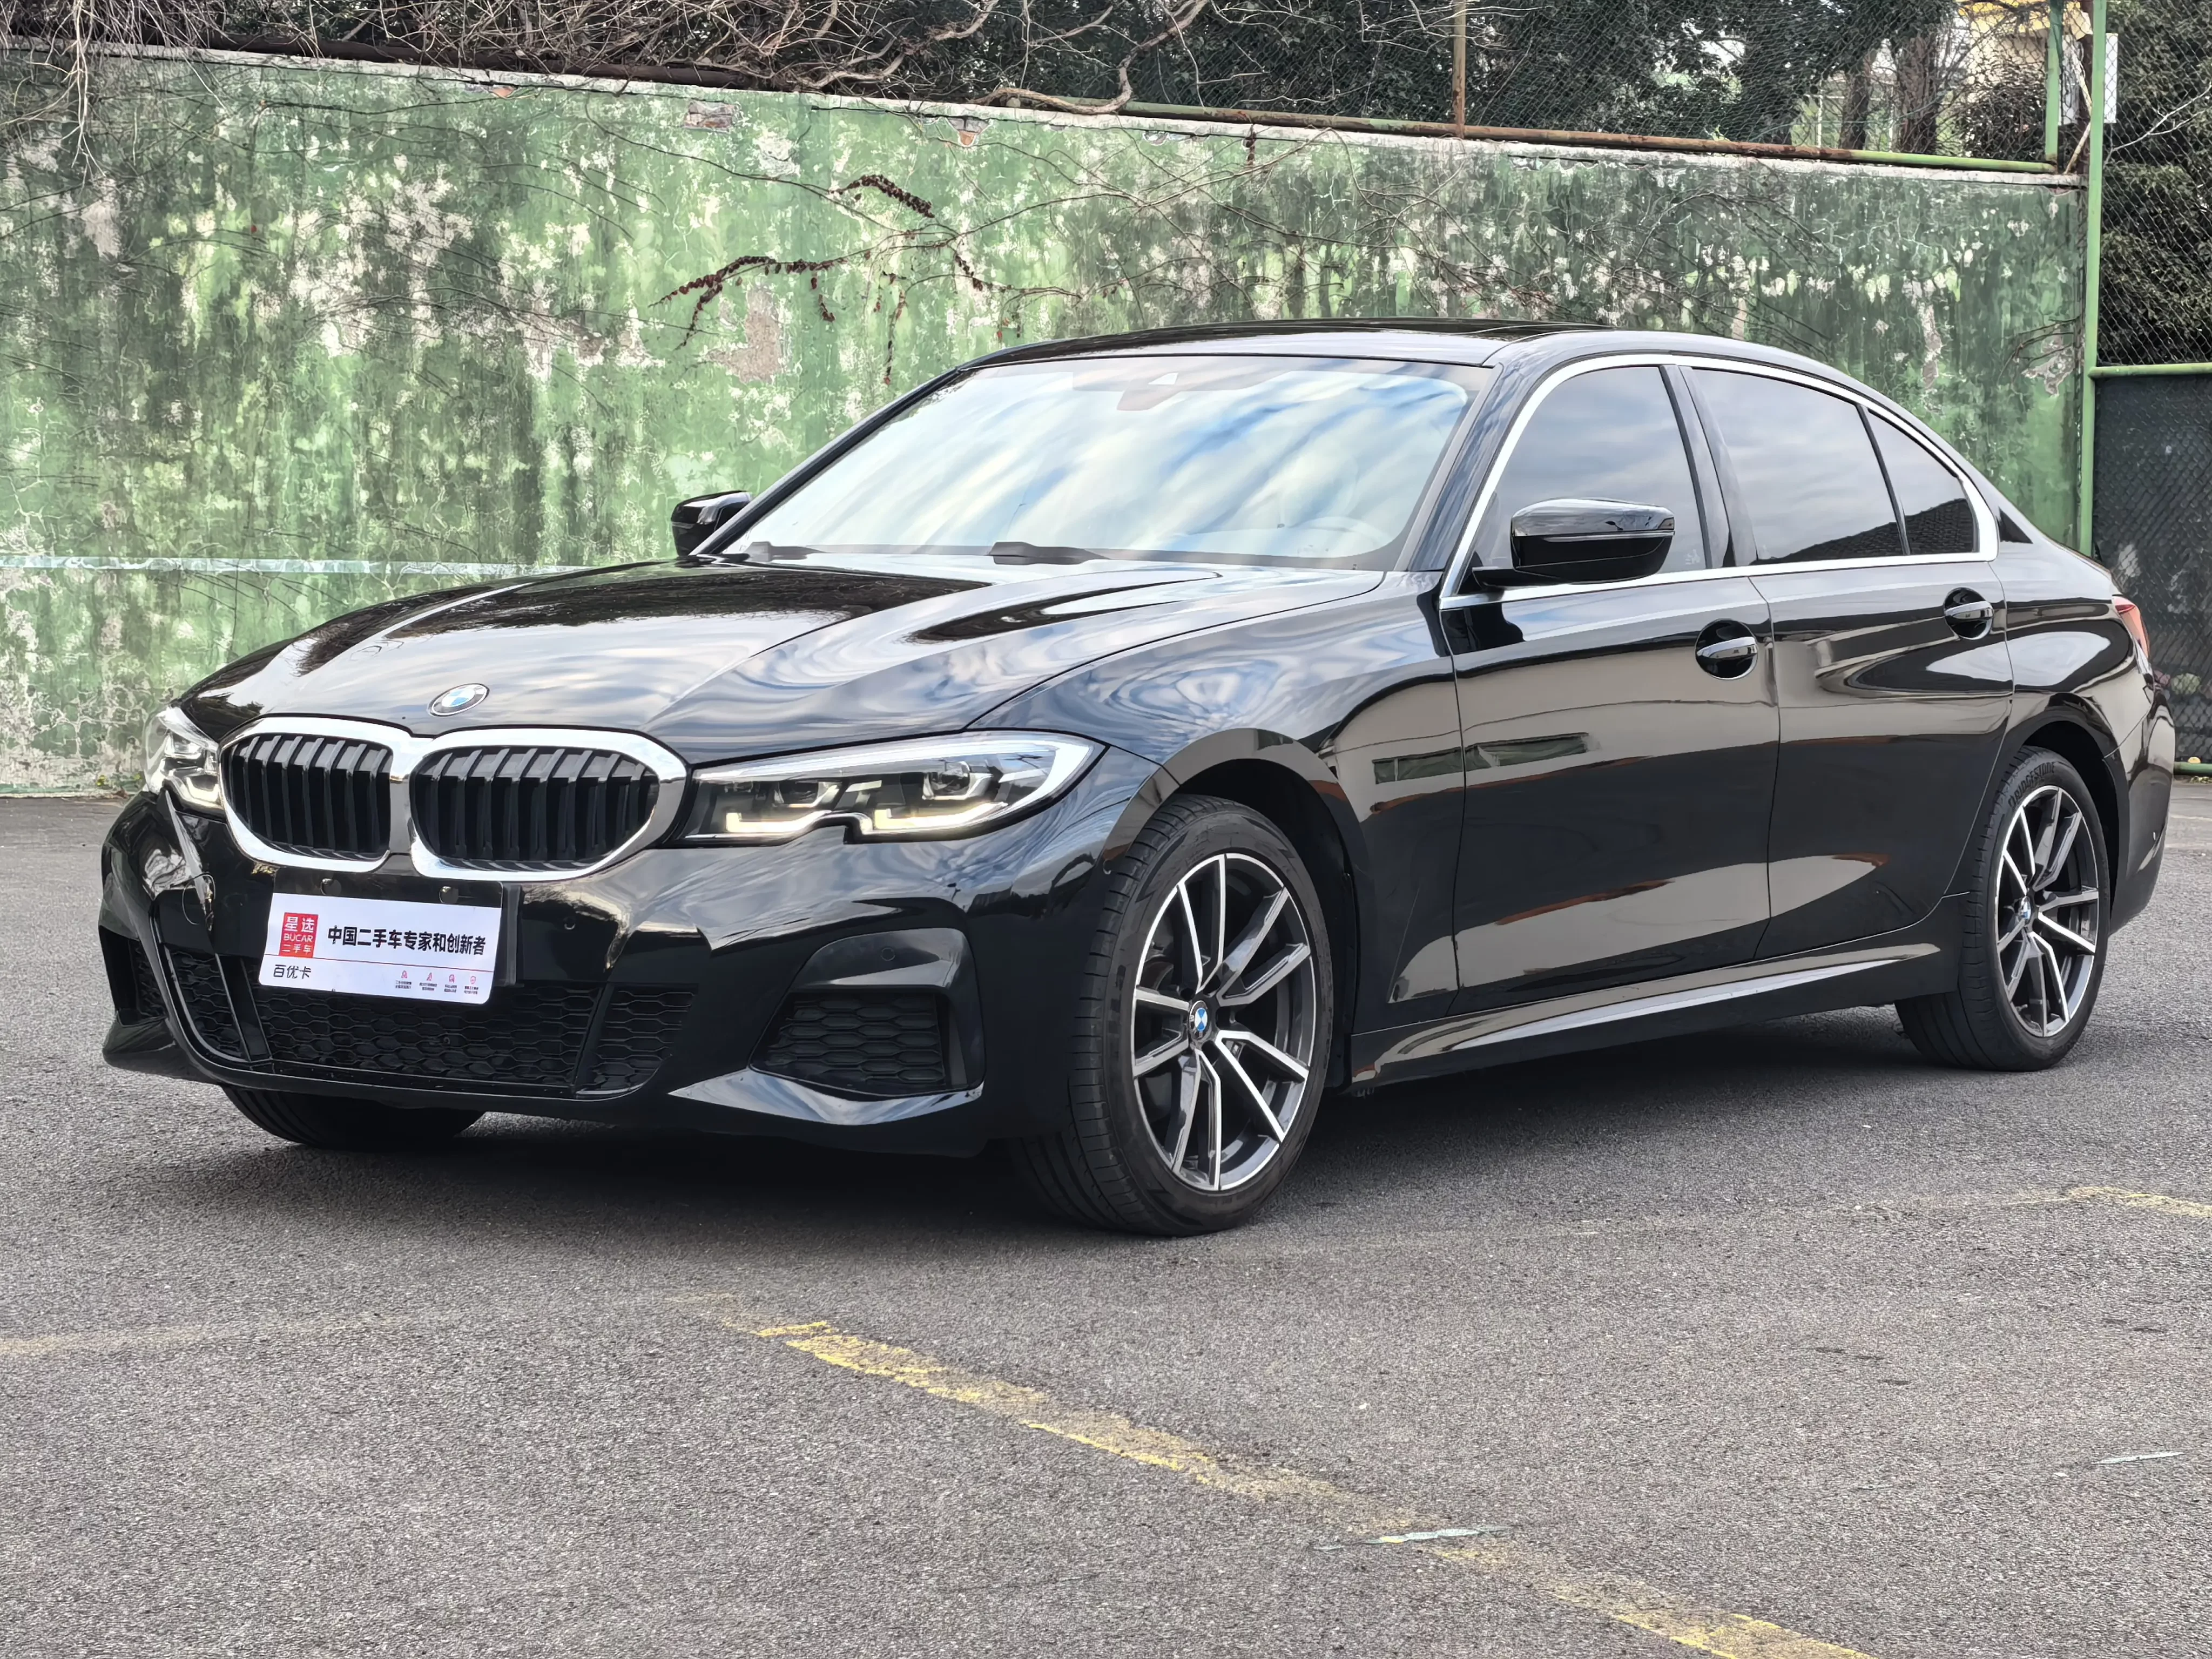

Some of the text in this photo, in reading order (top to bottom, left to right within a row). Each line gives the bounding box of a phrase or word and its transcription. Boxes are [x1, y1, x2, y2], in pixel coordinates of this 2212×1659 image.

[285, 916, 315, 933] 星选
[284, 933, 313, 942] BUCAR
[328, 926, 487, 955] 中国二手车专家和创新者
[282, 943, 313, 955] 二手车
[273, 965, 311, 979] 百优卡
